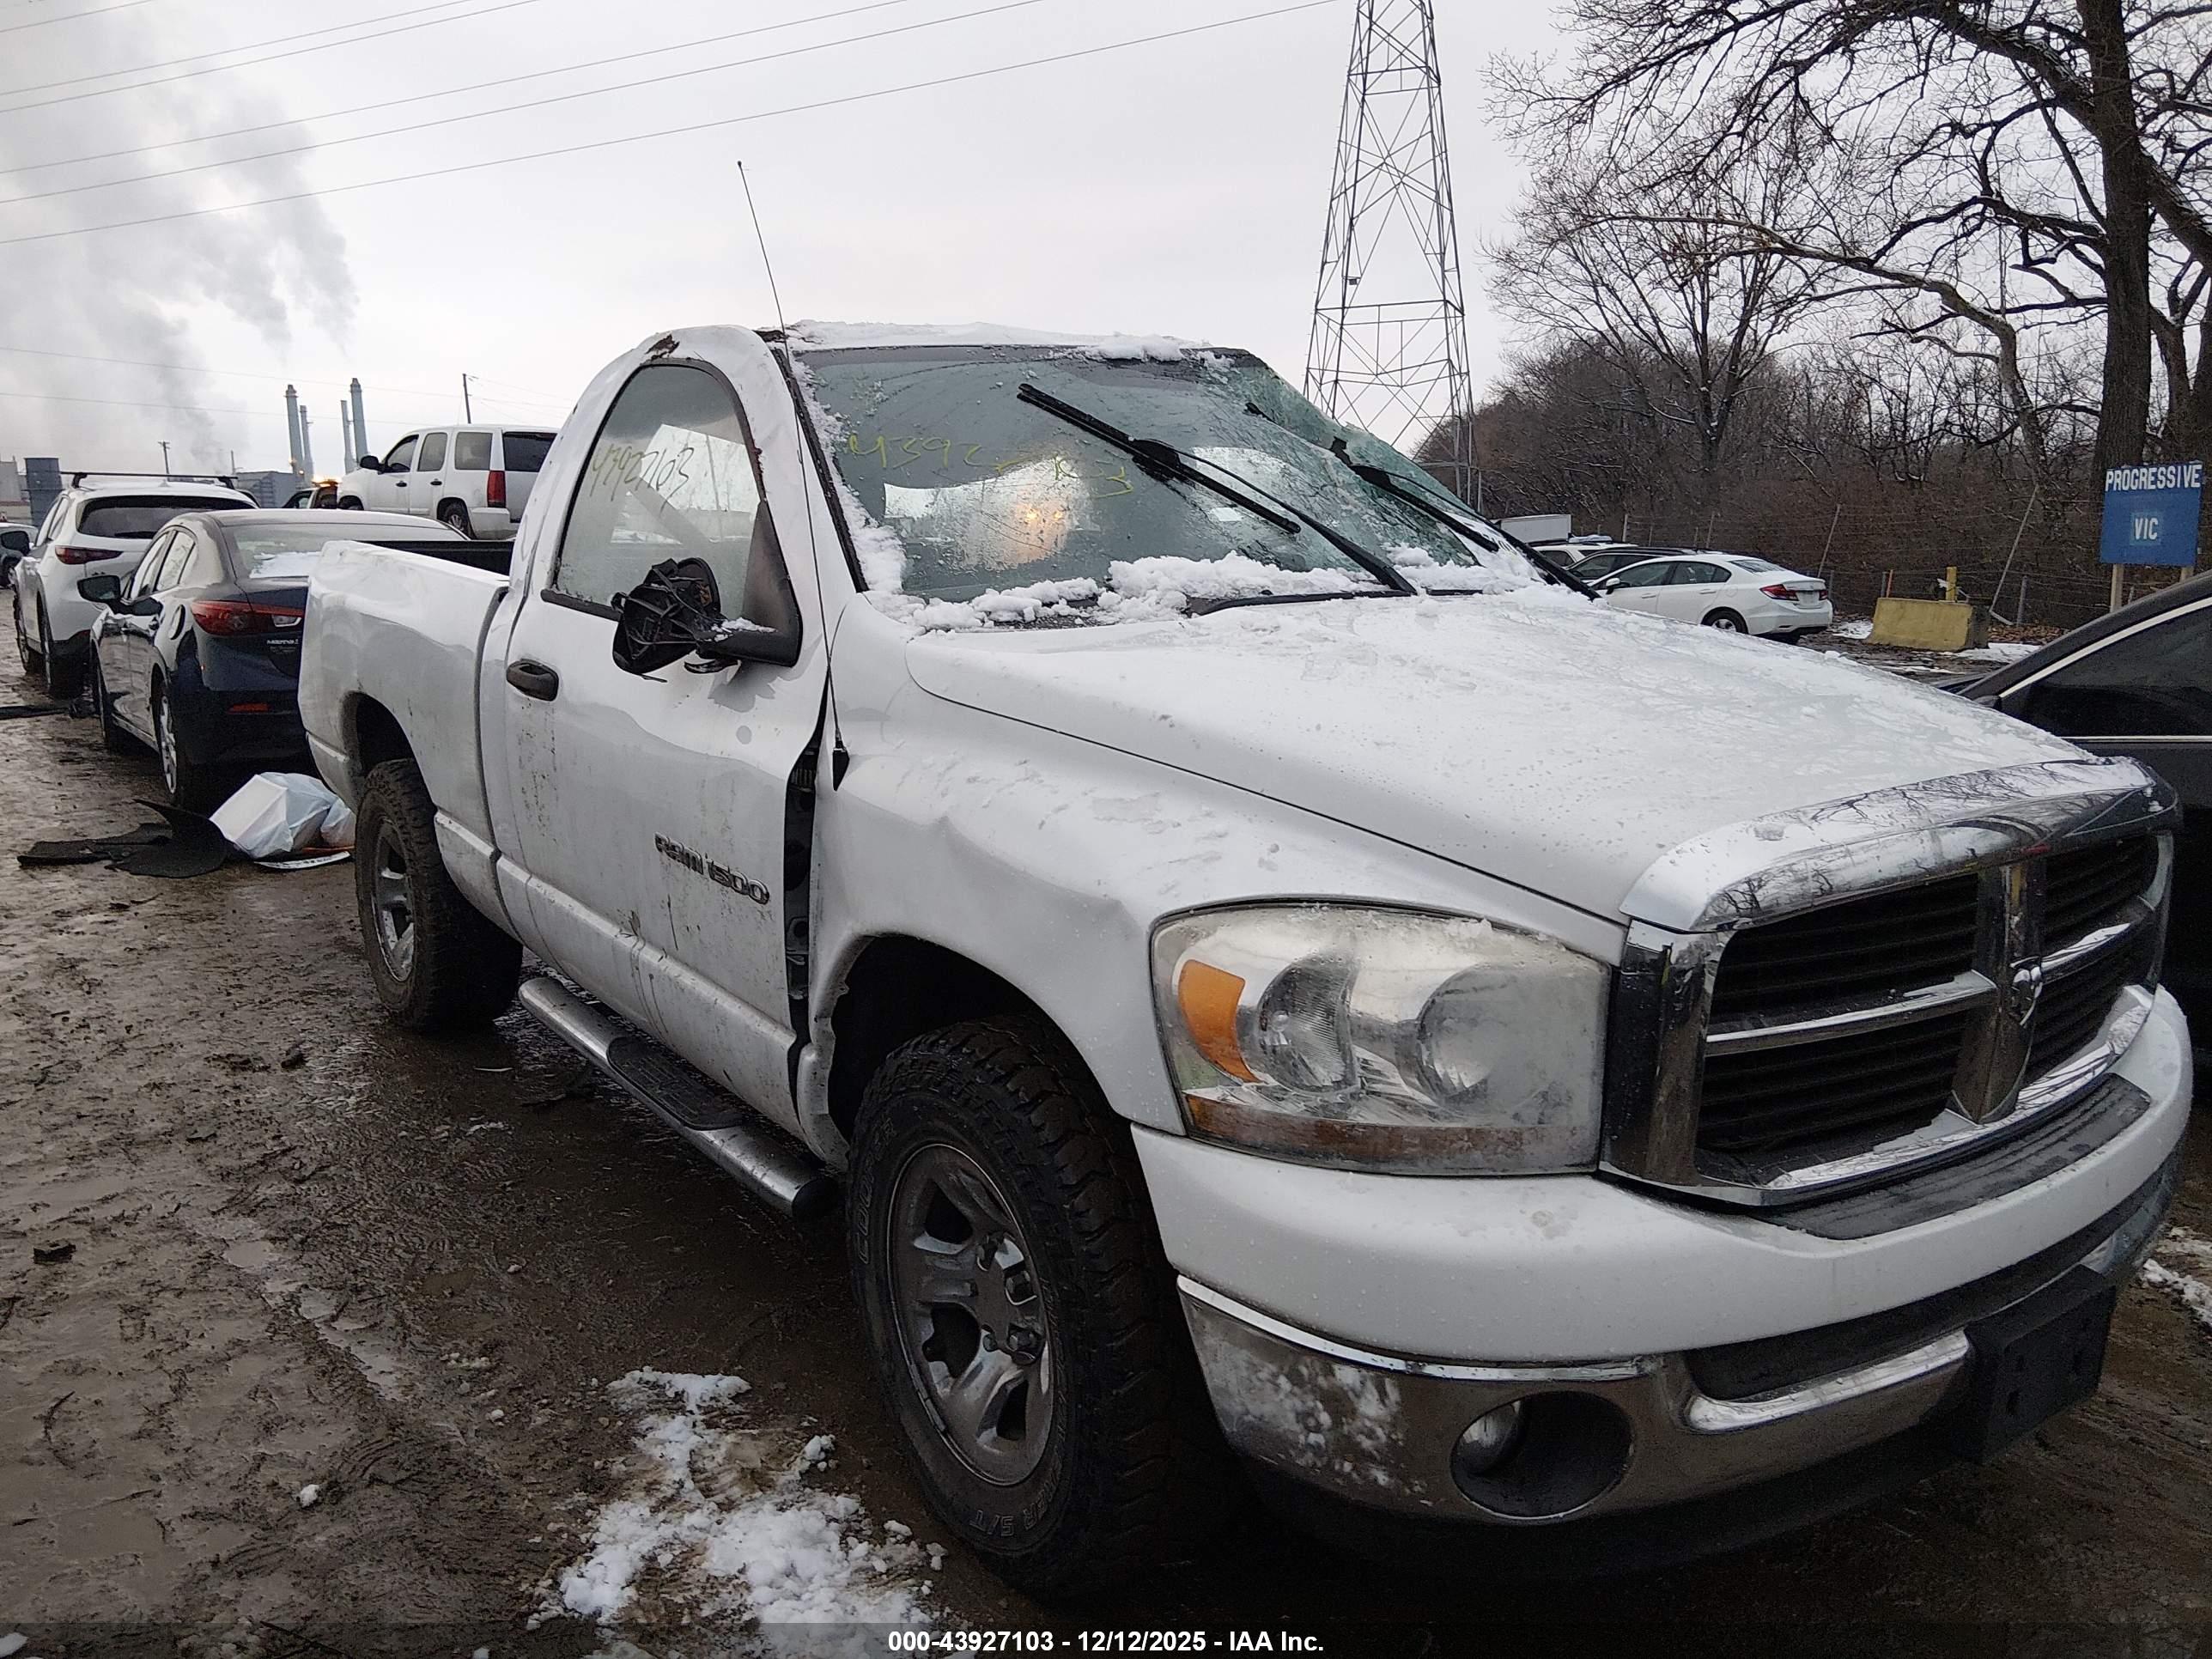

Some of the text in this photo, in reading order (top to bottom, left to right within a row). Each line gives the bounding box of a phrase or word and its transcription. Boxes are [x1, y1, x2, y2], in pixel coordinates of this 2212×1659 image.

[2105, 464, 2203, 492] PROGRESSIVE
[2134, 517, 2159, 540] VIC
[705, 853, 770, 906] 1500
